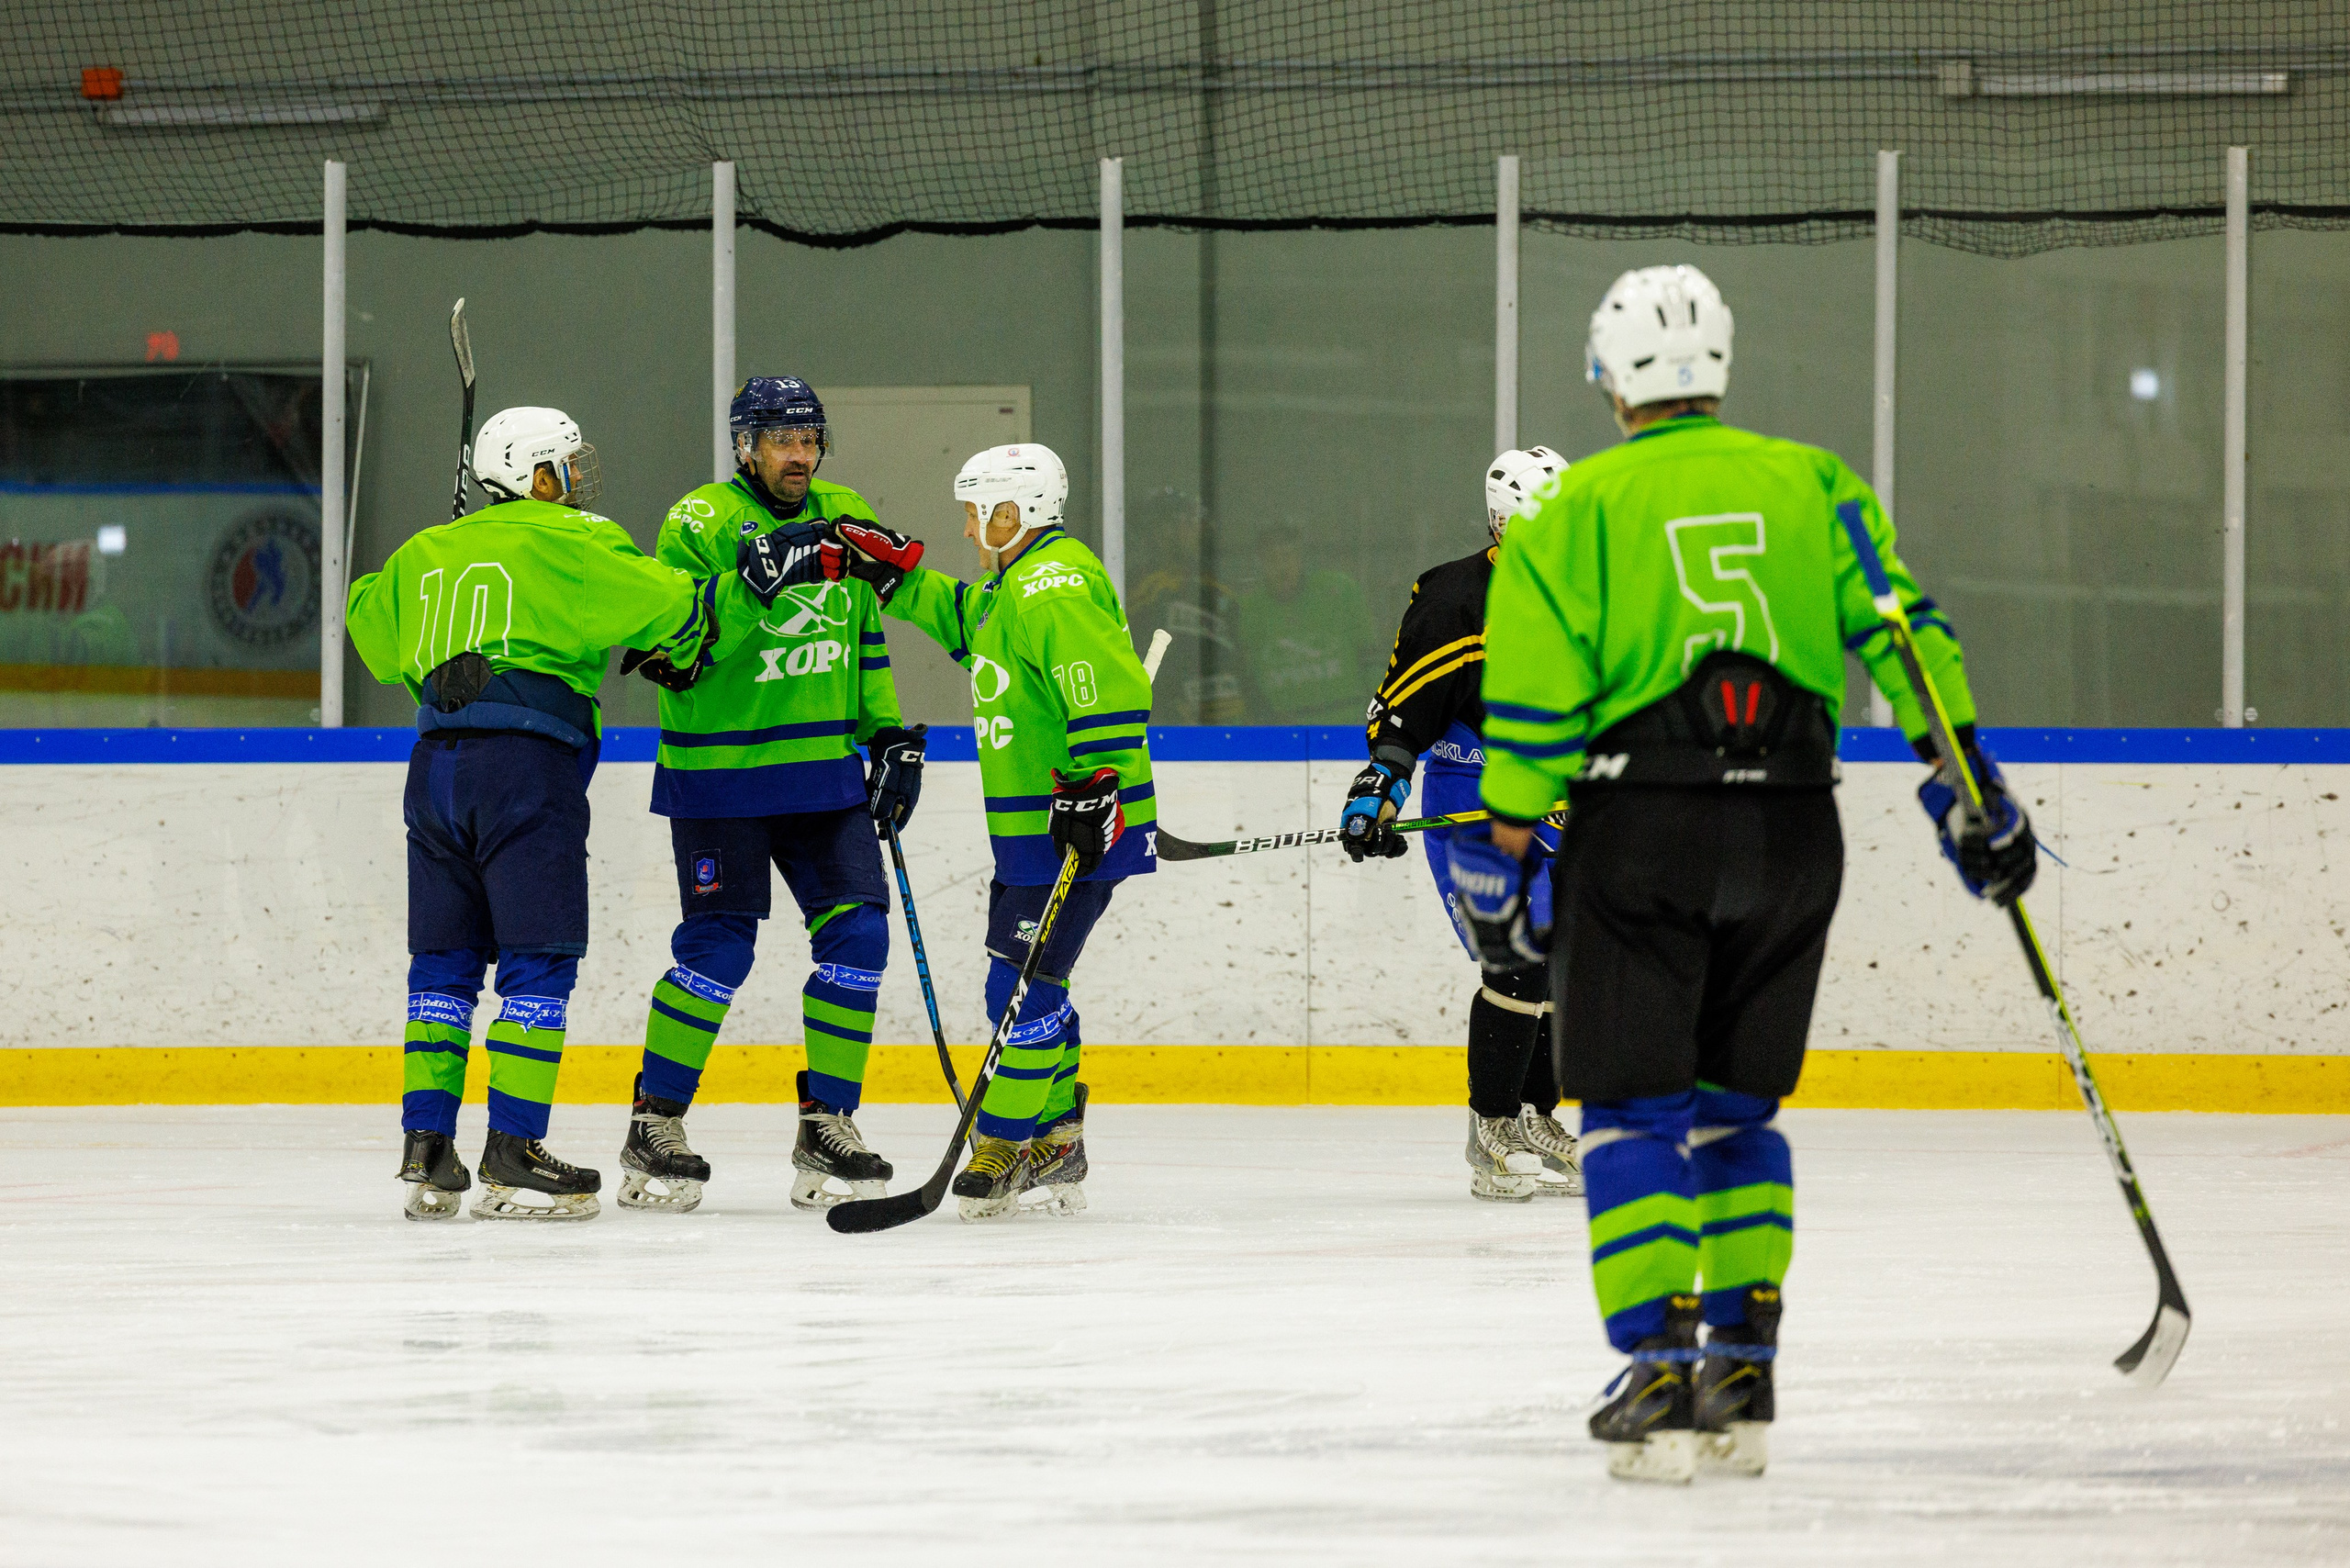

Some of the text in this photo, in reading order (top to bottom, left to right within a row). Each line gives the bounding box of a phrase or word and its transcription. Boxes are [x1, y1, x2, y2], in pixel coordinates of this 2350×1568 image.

[775, 379, 800, 388] 13
[532, 448, 555, 457] CCM
[845, 527, 867, 537] CCM
[1666, 512, 1778, 678] 5
[416, 563, 512, 679] 10
[1055, 790, 1118, 812] CCM
[982, 976, 1029, 1081] CCM
